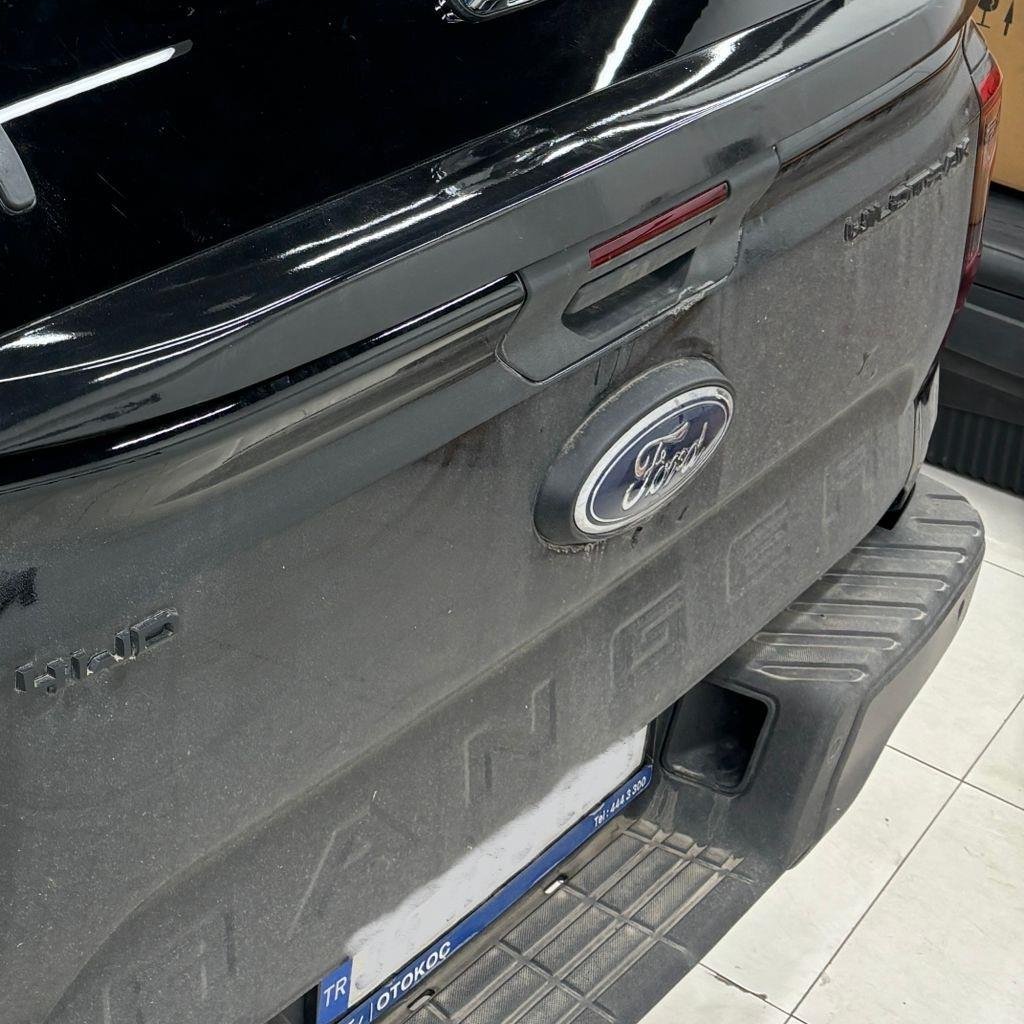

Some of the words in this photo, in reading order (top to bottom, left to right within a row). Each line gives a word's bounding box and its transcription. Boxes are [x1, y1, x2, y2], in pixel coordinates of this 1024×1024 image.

[622, 422, 708, 510] Ford
[323, 976, 348, 1007] TR
[376, 941, 451, 1011] OTOKOÇ
